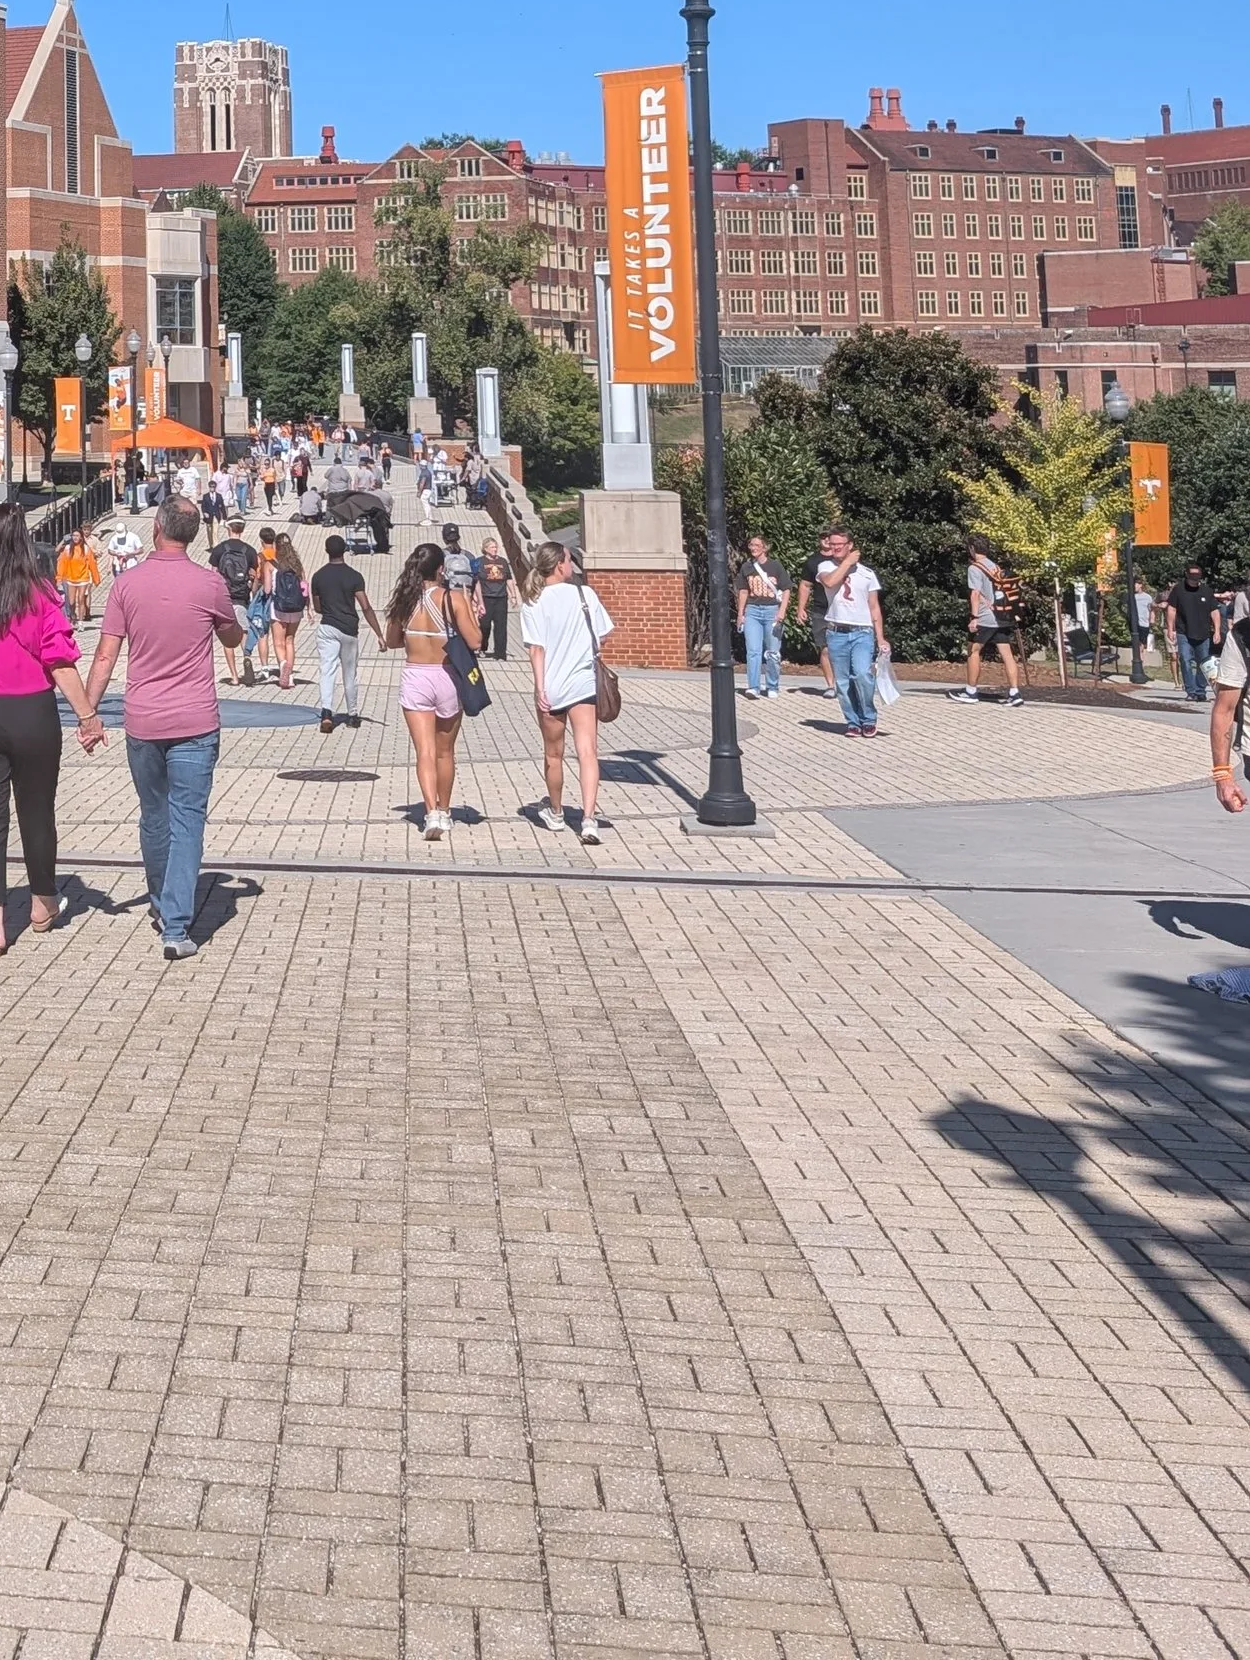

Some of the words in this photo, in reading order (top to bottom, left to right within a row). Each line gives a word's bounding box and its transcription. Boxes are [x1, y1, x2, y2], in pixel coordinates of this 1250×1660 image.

[623, 207, 638, 218] A
[640, 86, 676, 362] VOLUNTEER
[625, 231, 642, 297] TAKES
[629, 311, 644, 330] IT
[61, 405, 76, 420] T
